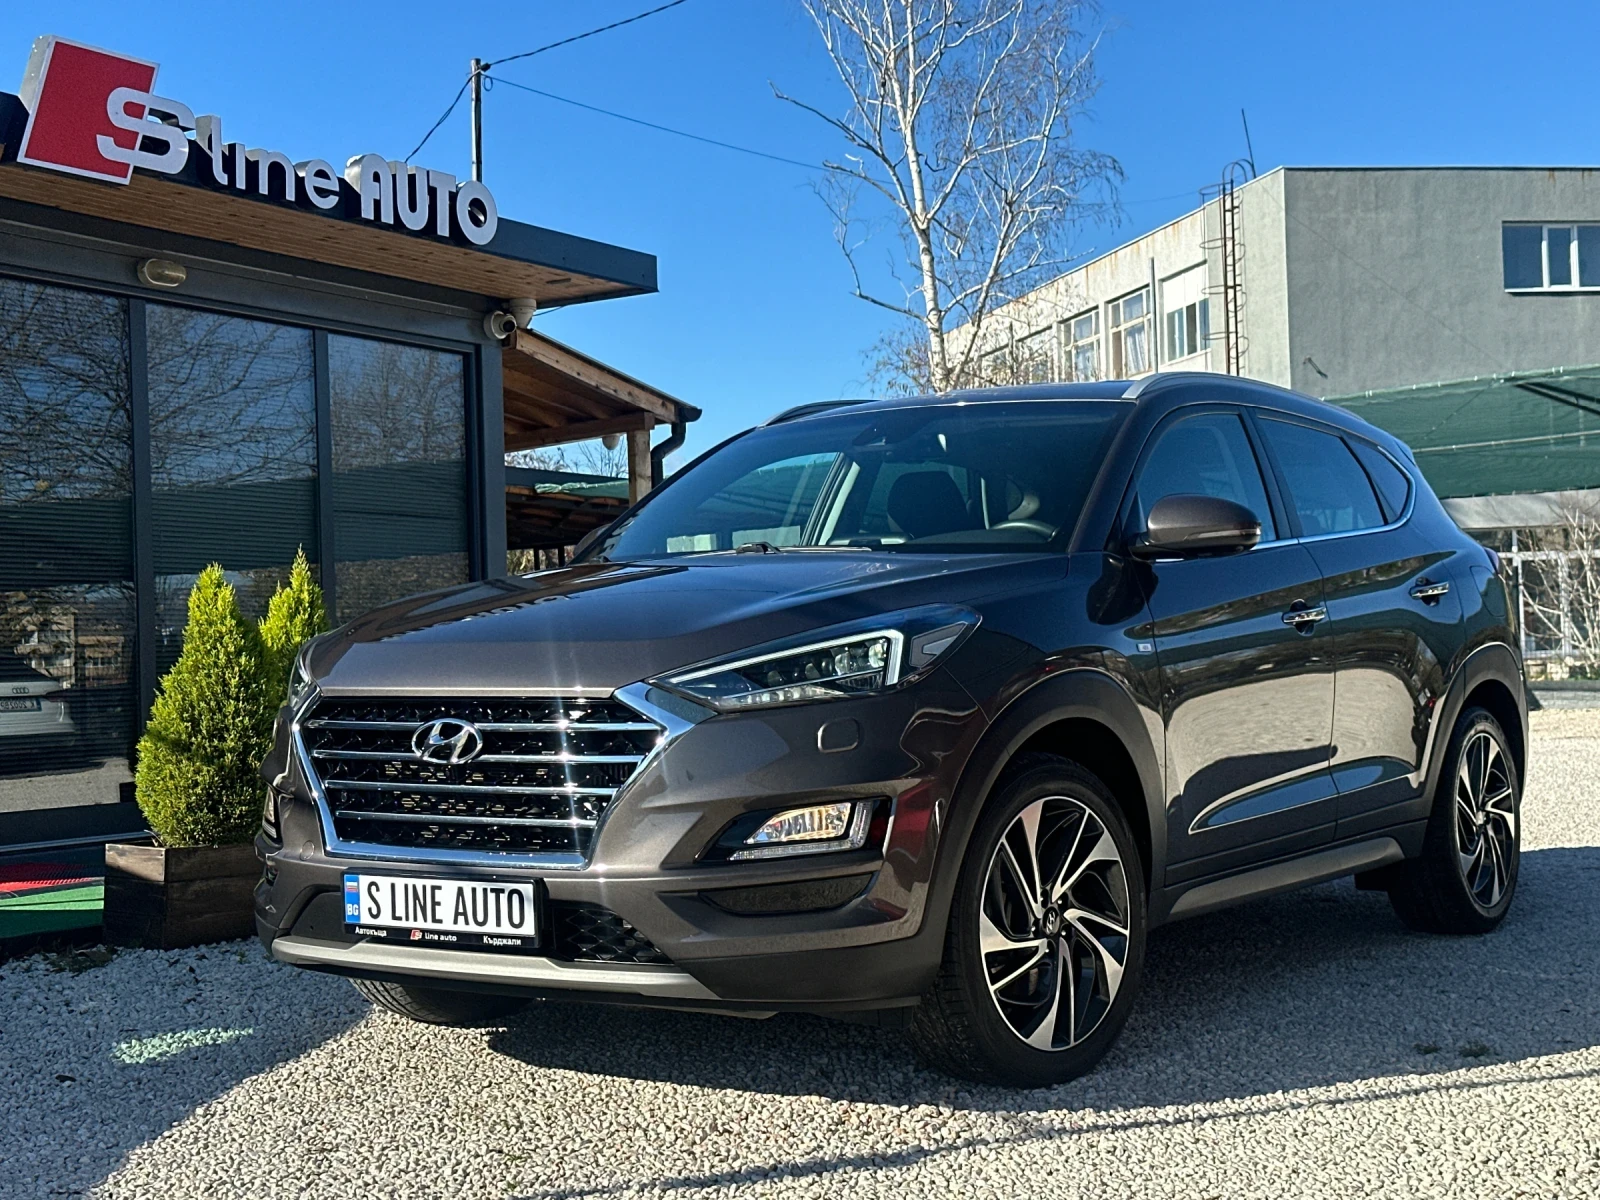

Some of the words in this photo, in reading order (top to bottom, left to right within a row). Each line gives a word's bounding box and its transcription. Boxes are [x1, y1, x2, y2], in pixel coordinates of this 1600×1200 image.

[96, 86, 194, 175] S
[357, 154, 498, 246] AUTO
[346, 903, 359, 916] BG
[367, 880, 382, 920] S
[390, 882, 443, 925] LINE
[453, 886, 526, 930] AUTO
[439, 934, 458, 942] auto
[483, 935, 522, 947] Кърджали
